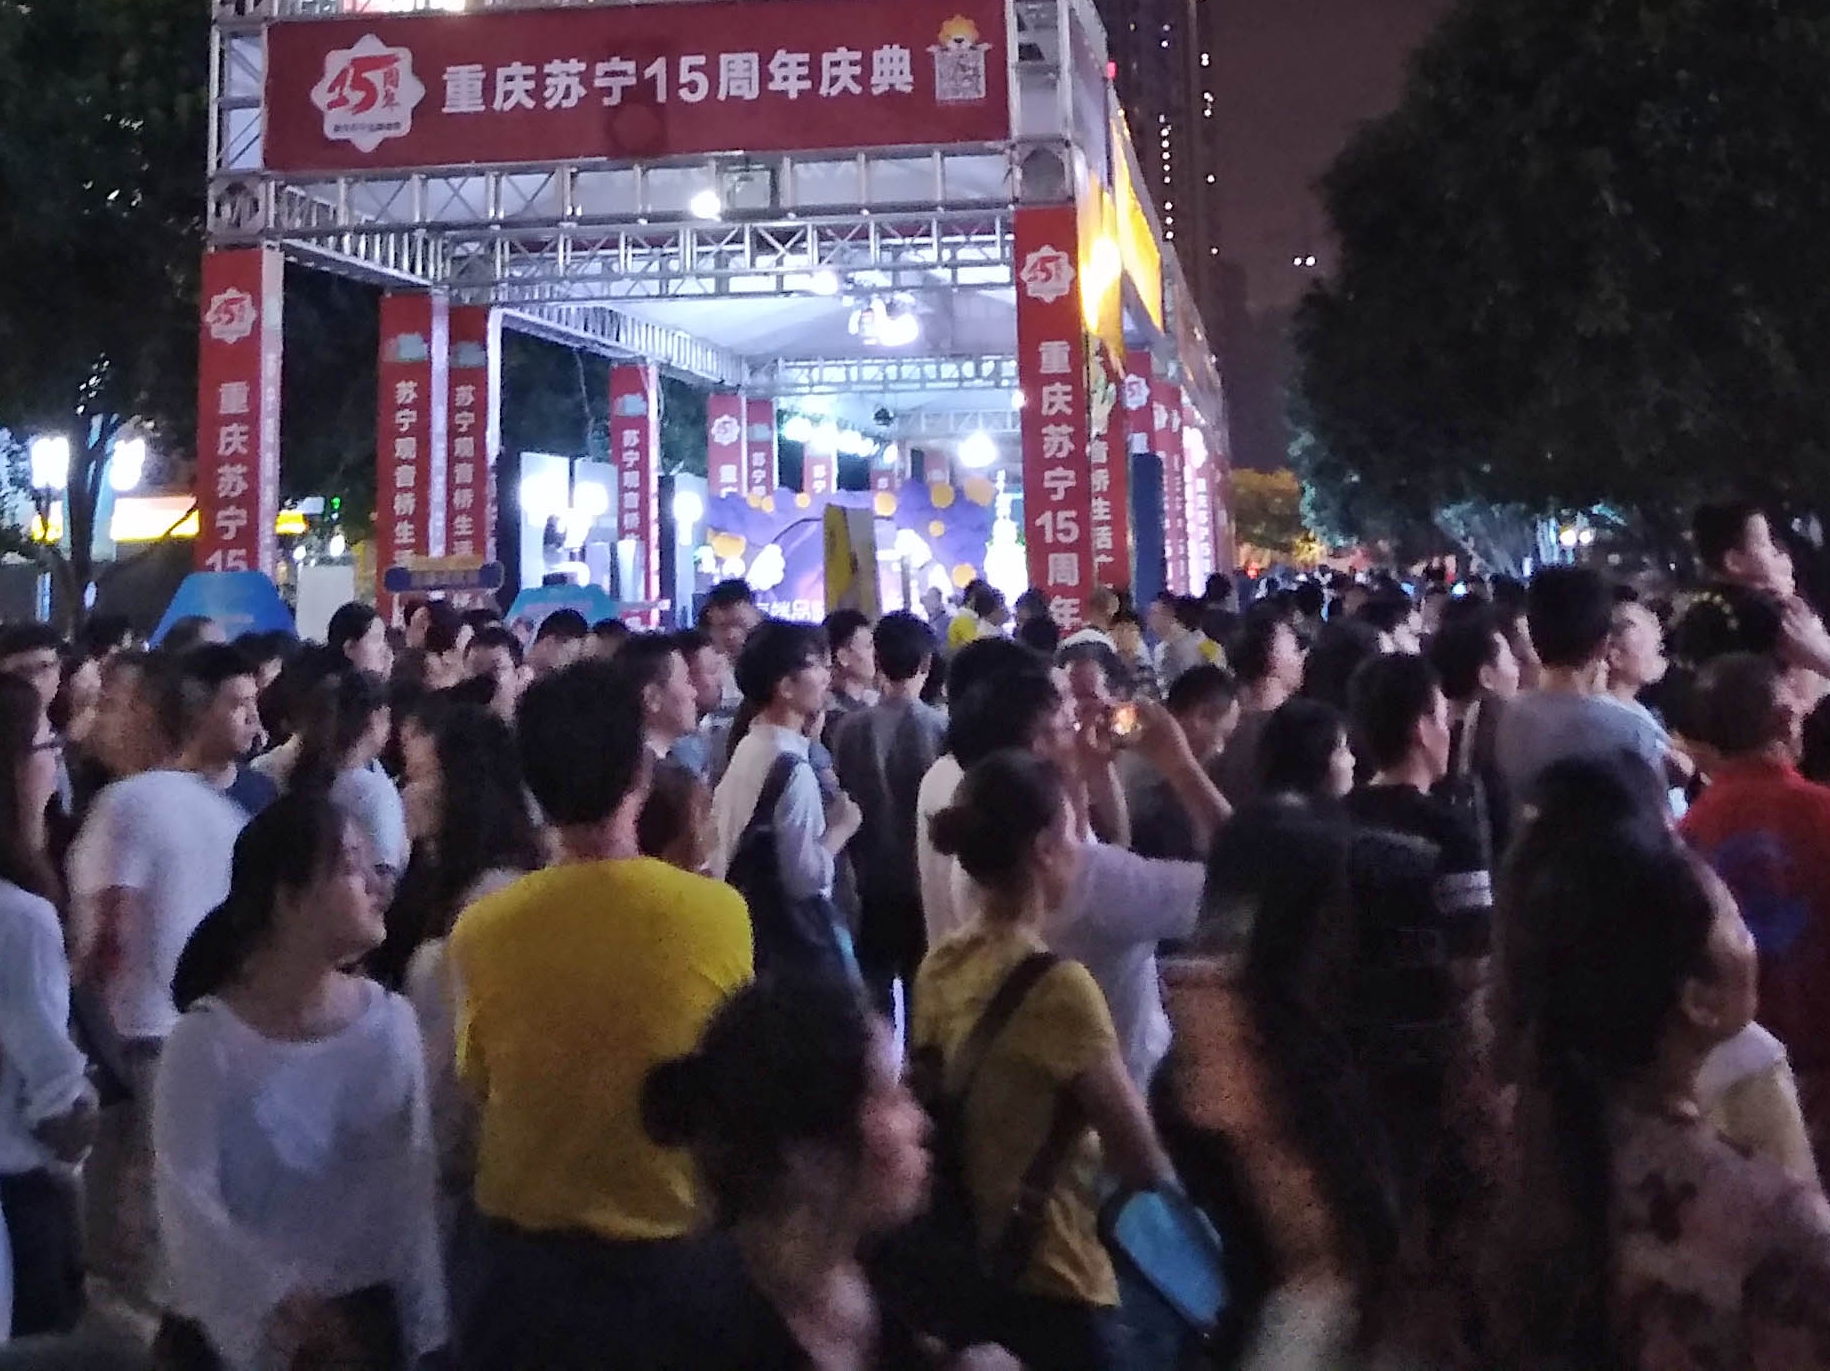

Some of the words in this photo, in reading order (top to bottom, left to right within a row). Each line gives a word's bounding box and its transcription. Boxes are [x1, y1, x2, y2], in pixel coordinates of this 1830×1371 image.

[441, 44, 915, 115] 重庆苏宁15周年庆典
